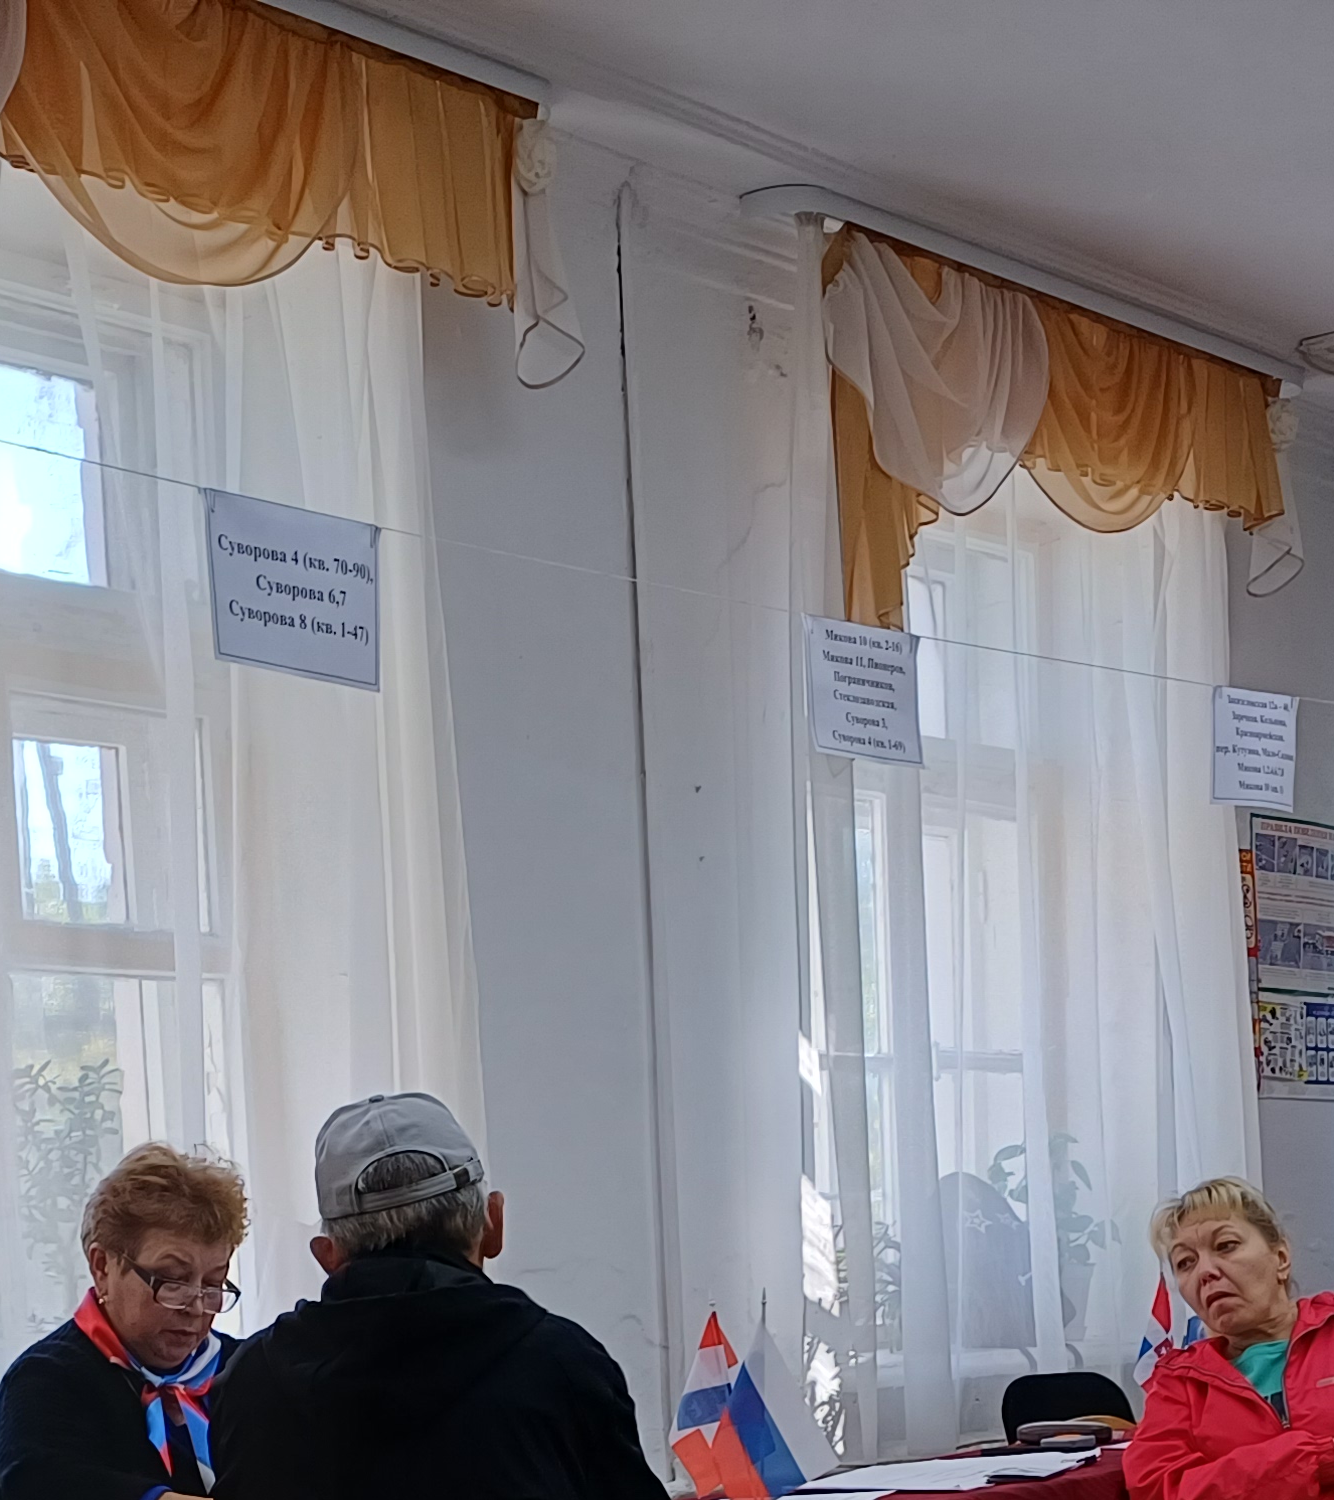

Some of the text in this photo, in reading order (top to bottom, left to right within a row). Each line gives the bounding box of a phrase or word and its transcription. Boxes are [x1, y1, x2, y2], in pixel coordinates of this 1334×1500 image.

[218, 533, 374, 585] Суворова 4 (кв. 70-90),
[256, 574, 347, 608] Суворова 6,7
[229, 599, 369, 647] Суворова 8 (кв. 1-47)
